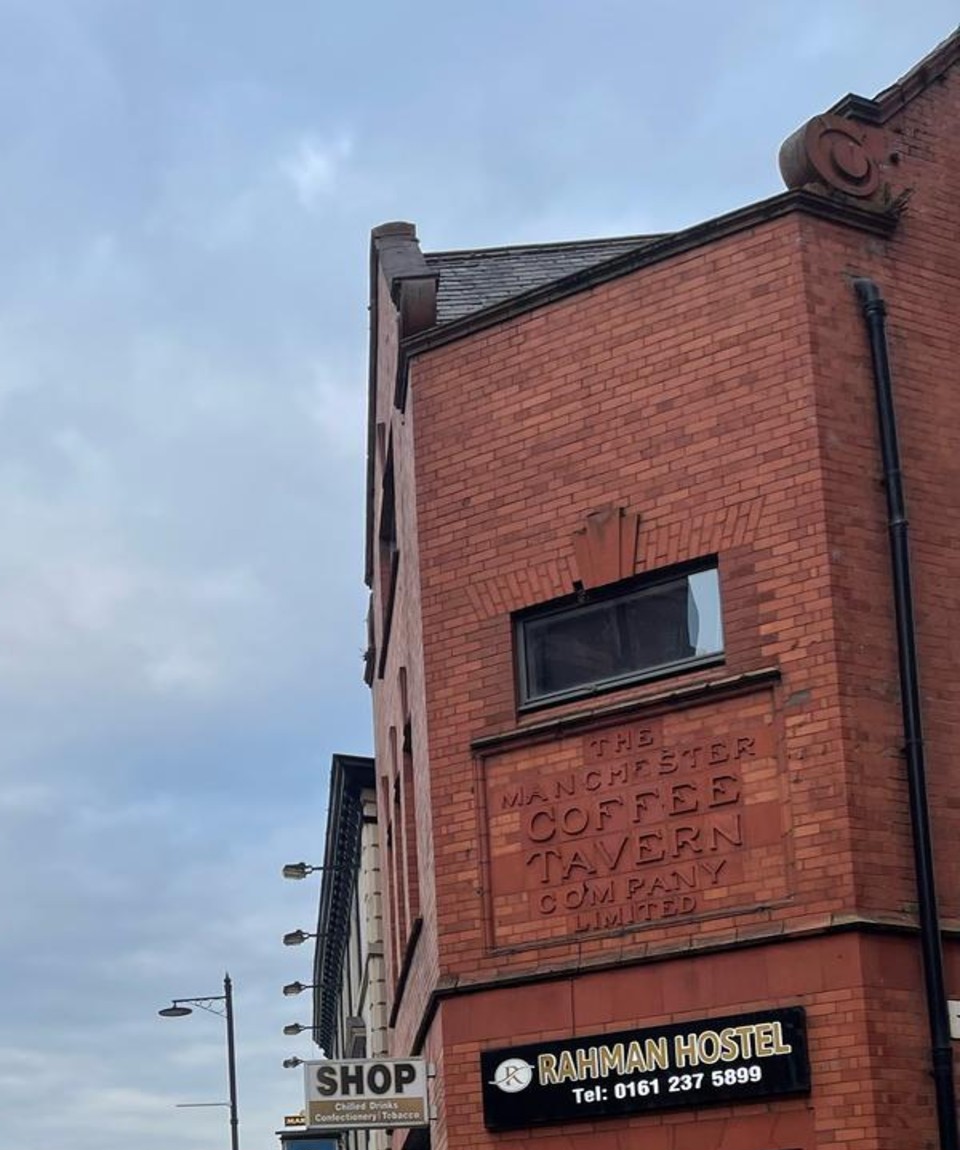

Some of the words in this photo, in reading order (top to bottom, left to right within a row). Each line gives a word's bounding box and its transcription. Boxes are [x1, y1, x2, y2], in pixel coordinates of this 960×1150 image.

[590, 729, 654, 757] THE
[501, 737, 756, 809] MANCHESTER
[528, 775, 740, 843] COFFEE
[526, 814, 743, 884] TAVERN
[540, 859, 728, 915] COMPANY
[575, 897, 697, 933] LIMITED
[538, 1036, 668, 1086] RAHMAN
[674, 1021, 792, 1068] HOSTEL
[316, 1063, 417, 1096] SHOP
[572, 1087, 608, 1104] Tel:
[614, 1080, 660, 1100] 0161
[668, 1073, 704, 1093] 237
[711, 1065, 762, 1088] 5899
[314, 1112, 377, 1122] Confectionery
[382, 1111, 420, 1120] Tobacco
[334, 1102, 367, 1111] Chilled
[369, 1101, 399, 1110] Drinks
